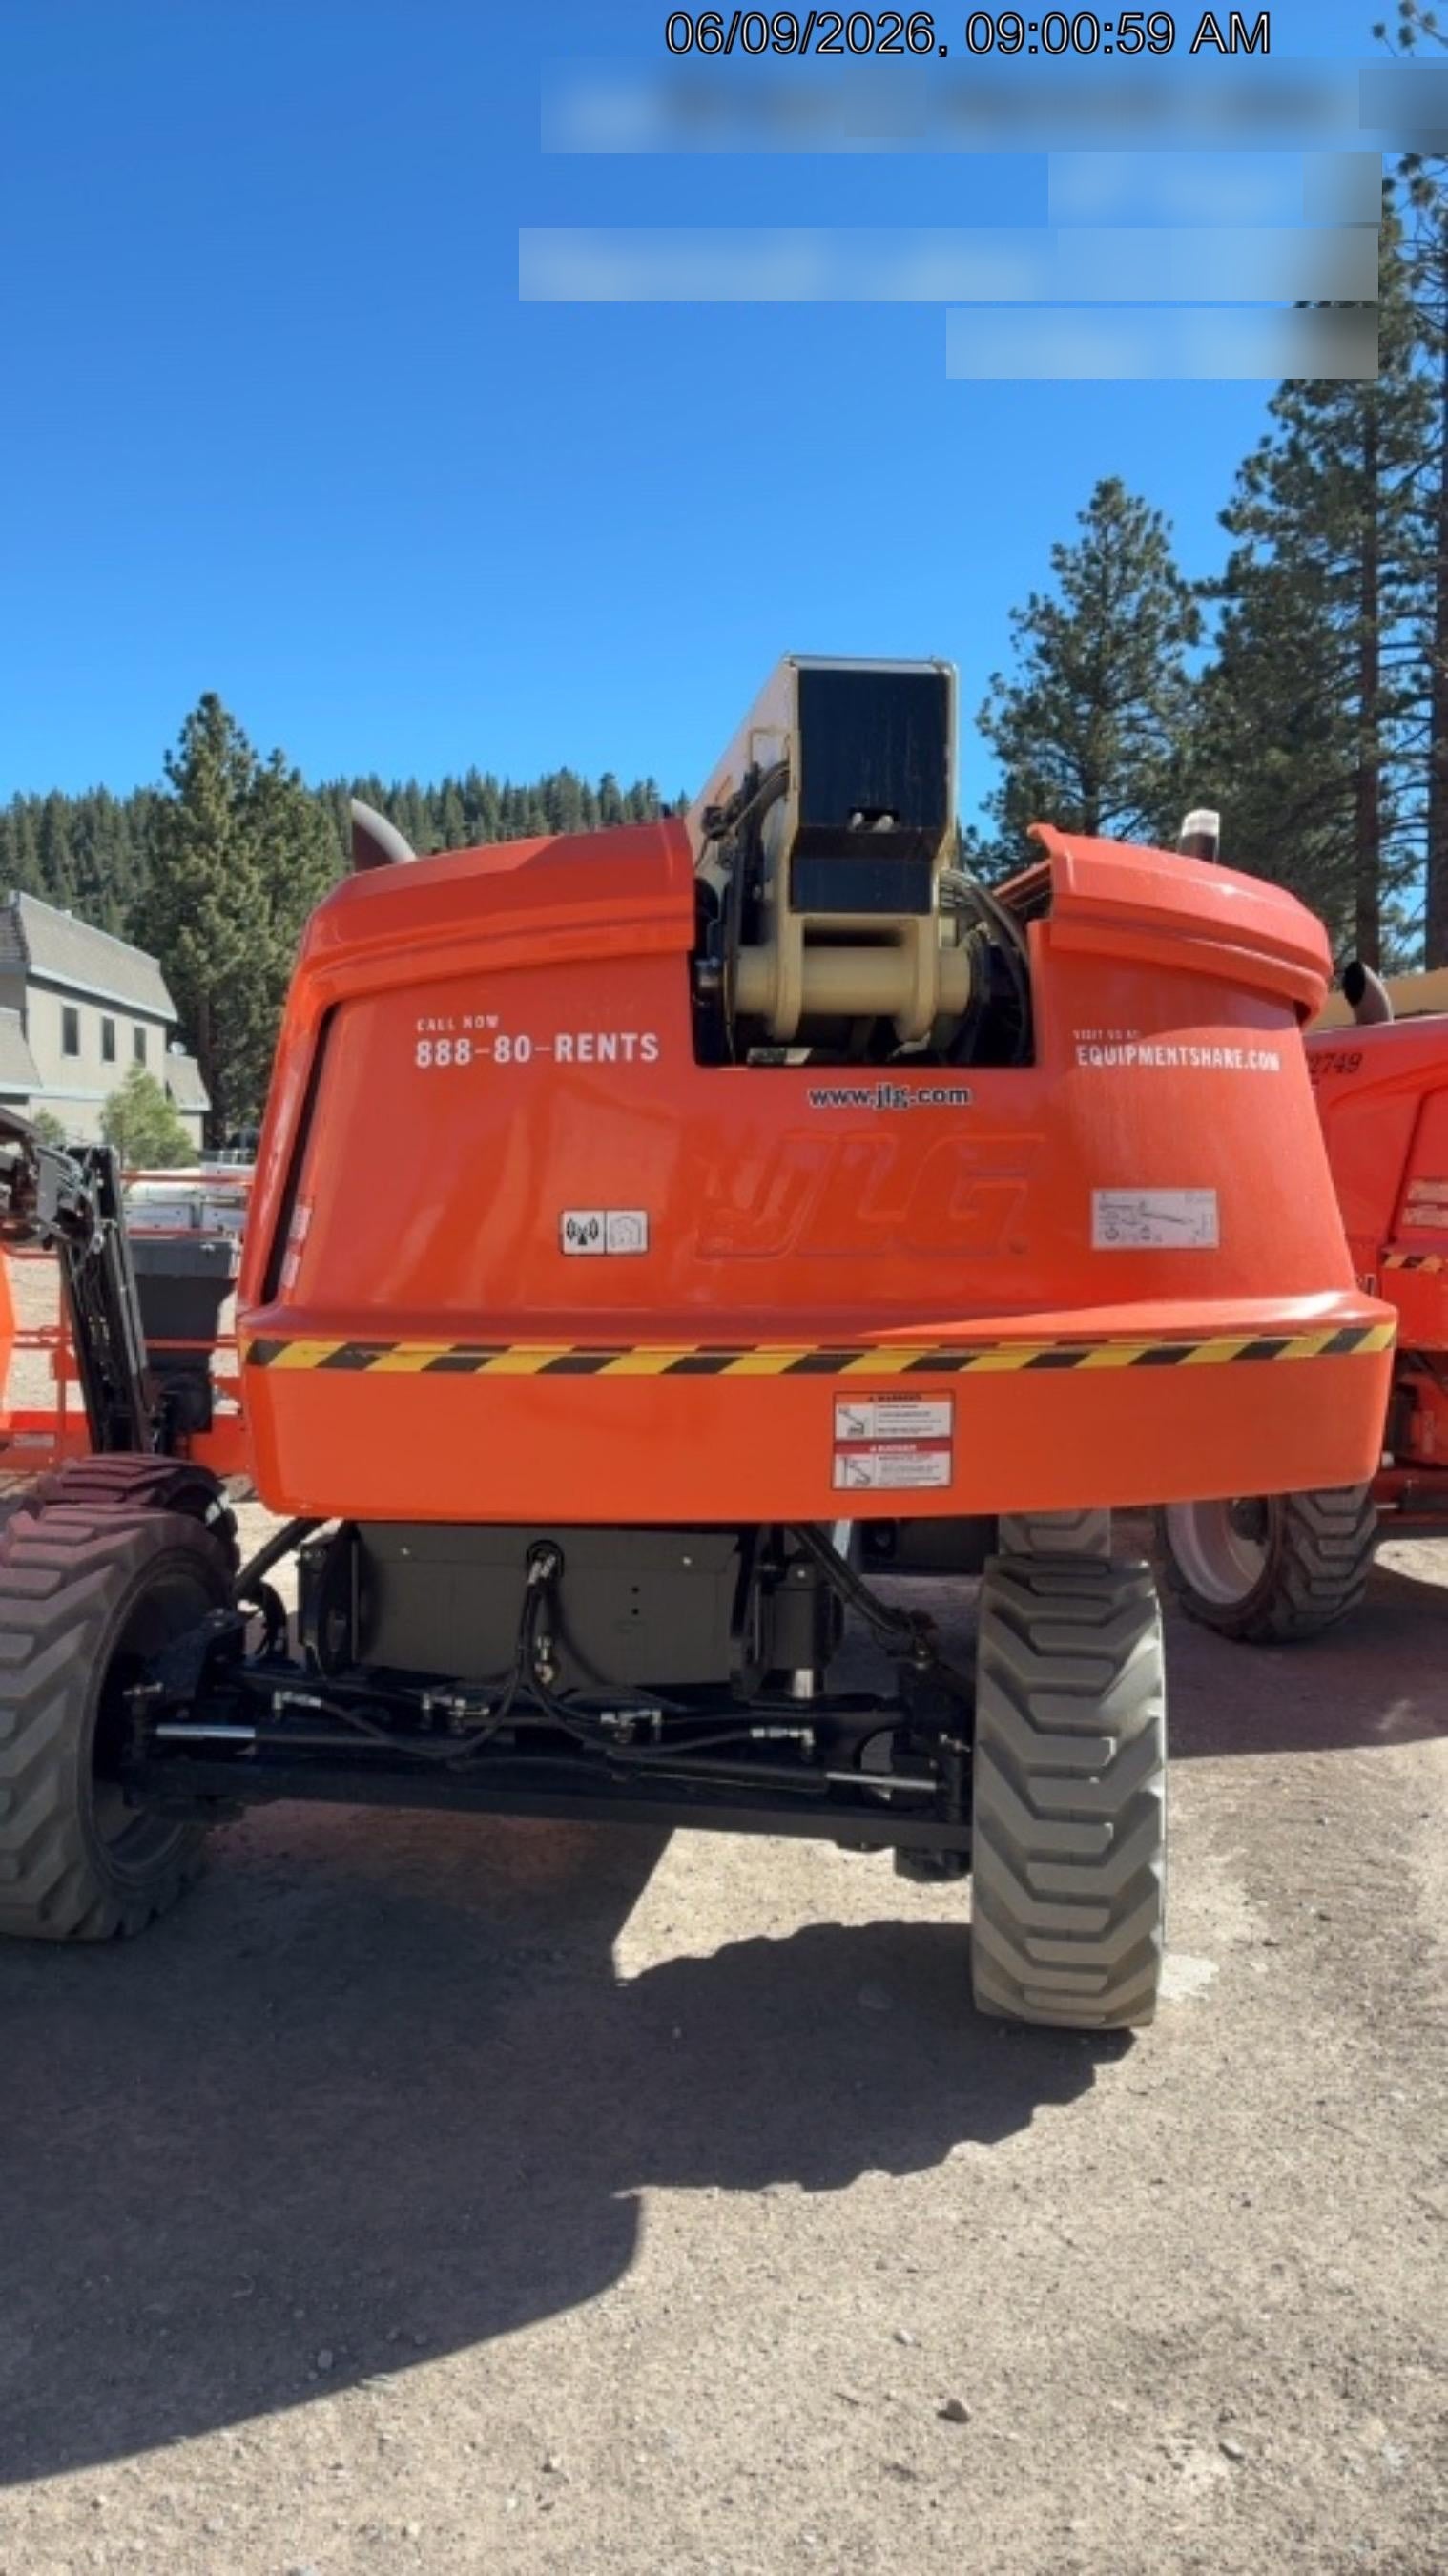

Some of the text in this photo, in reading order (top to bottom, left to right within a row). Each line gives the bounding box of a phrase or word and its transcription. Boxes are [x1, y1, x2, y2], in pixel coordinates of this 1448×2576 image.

[416, 1014, 498, 1032] CALL NOW
[415, 1032, 659, 1068] 888-80-RENTS
[1075, 1044, 1280, 1072] EQUIPMENTSHARE.COM
[808, 1082, 971, 1110] www.jlg.com
